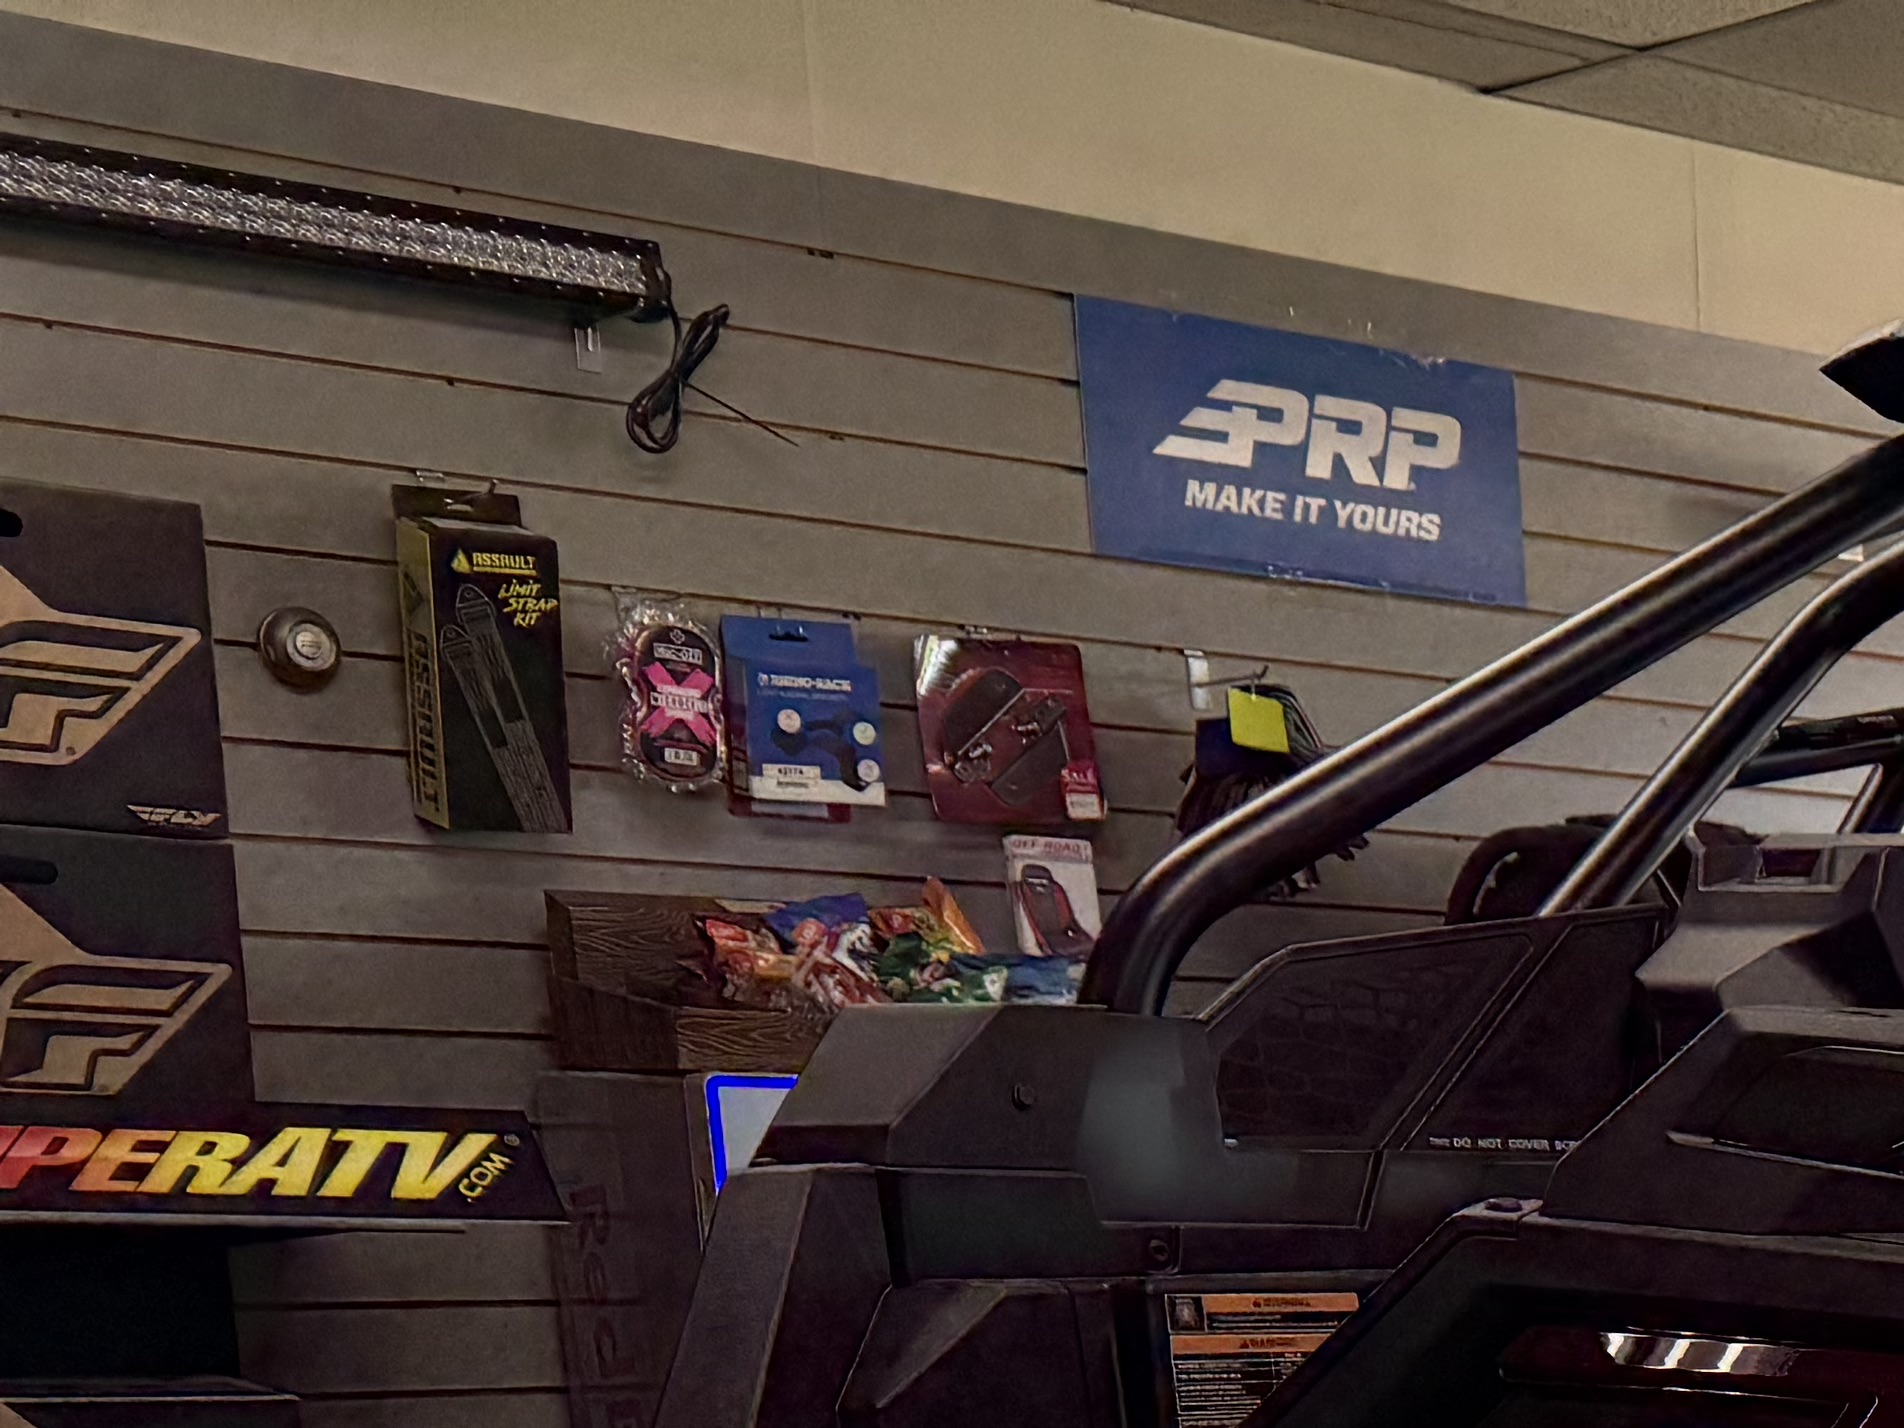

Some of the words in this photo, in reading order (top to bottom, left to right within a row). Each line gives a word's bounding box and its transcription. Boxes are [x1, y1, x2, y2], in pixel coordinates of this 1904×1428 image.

[1152, 379, 1462, 490] PRP
[1184, 479, 1287, 521] MAKE
[1294, 495, 1328, 525] IT
[1333, 499, 1442, 541] YOURS
[472, 552, 536, 570] ASSAULT
[498, 579, 542, 598] LIMIT
[503, 598, 559, 613] STRAP
[513, 612, 542, 628] KIT
[1453, 1137, 1472, 1149] DO
[1477, 1138, 1502, 1150] NOT
[1508, 1138, 1551, 1152] COVER
